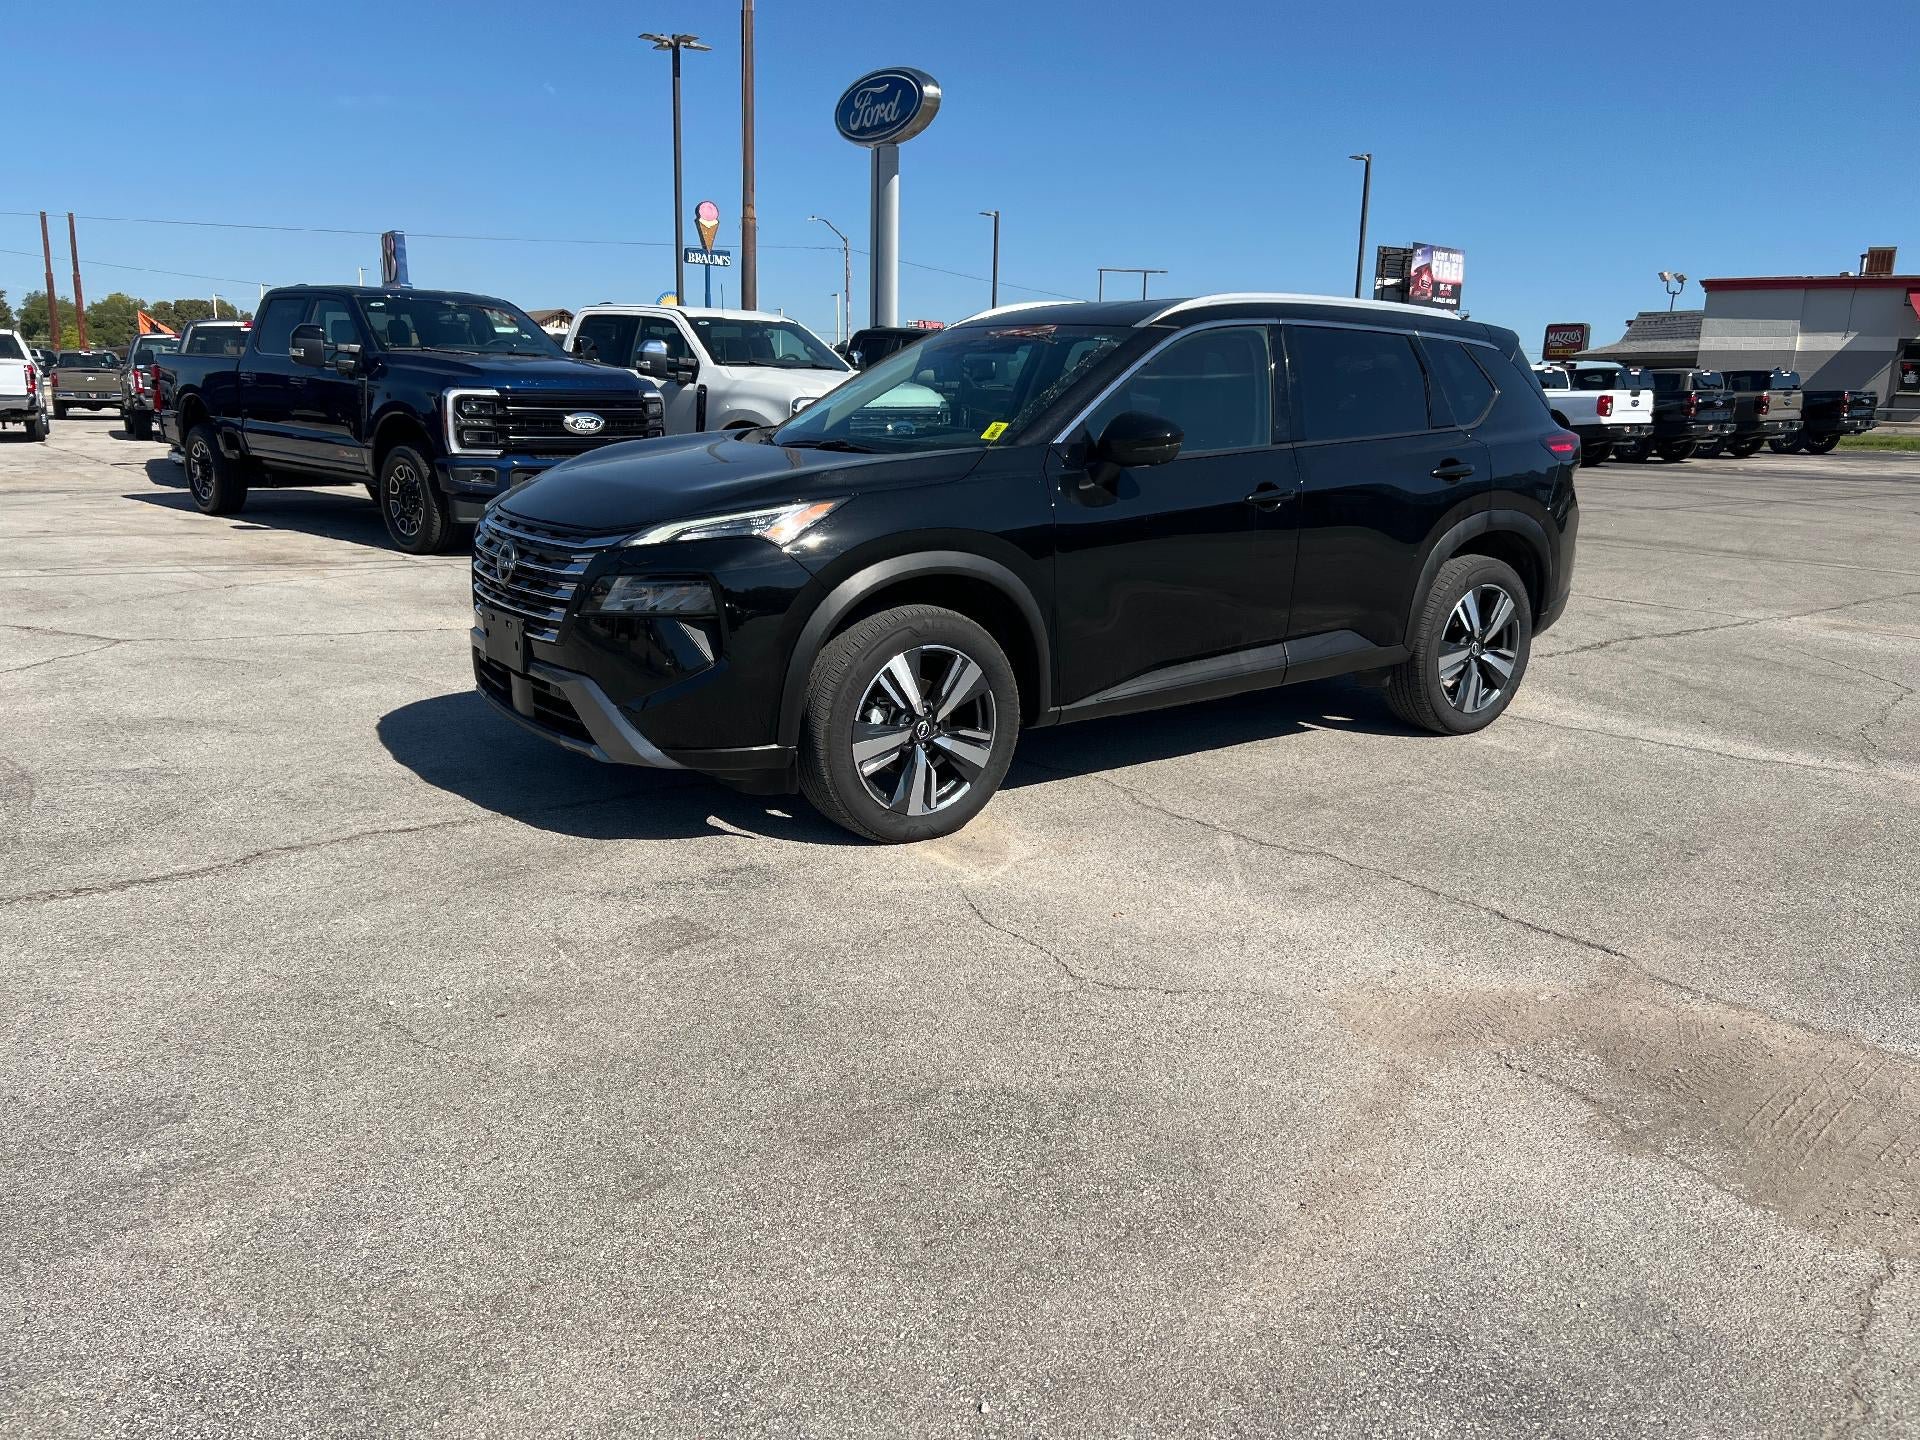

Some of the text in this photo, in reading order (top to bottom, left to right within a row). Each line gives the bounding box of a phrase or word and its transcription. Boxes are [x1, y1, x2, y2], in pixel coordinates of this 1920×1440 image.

[849, 83, 902, 131] Ford
[688, 252, 730, 265] BRAUM'S
[1548, 330, 1581, 344] MAZZIO'S
[575, 419, 598, 430] Ford
